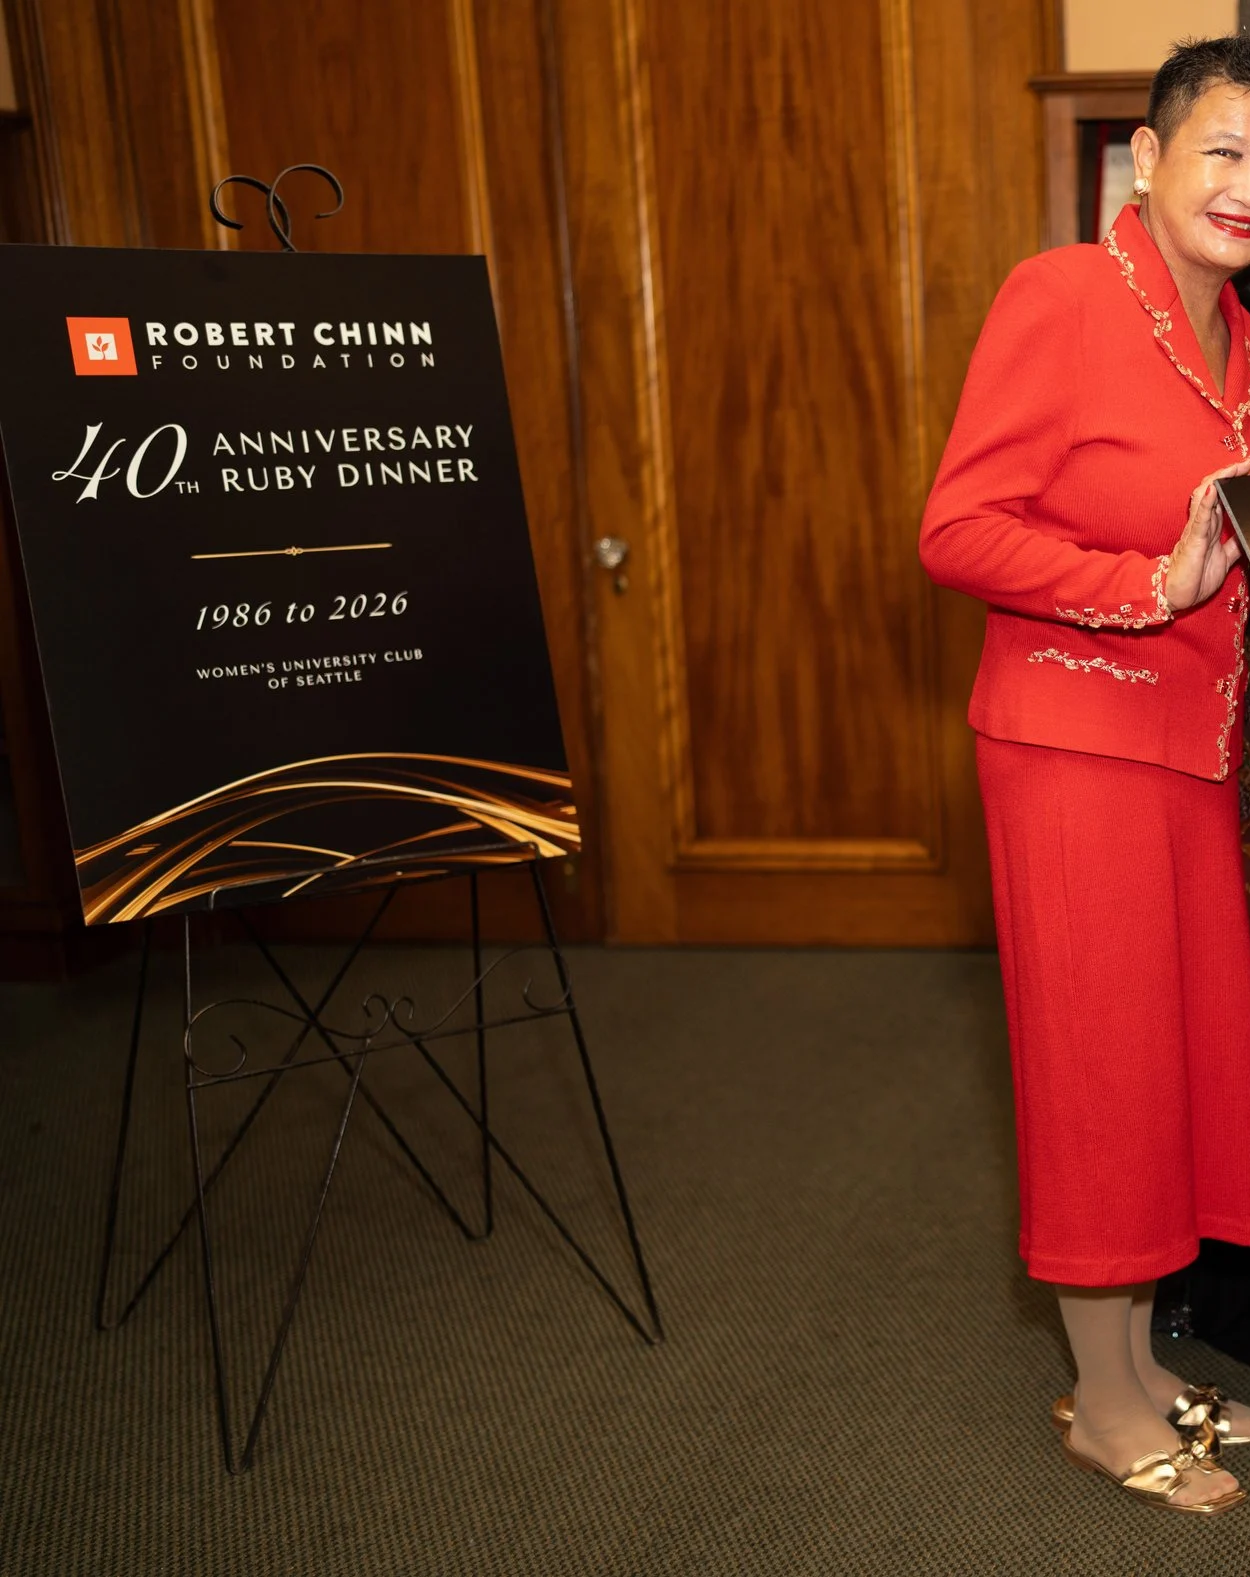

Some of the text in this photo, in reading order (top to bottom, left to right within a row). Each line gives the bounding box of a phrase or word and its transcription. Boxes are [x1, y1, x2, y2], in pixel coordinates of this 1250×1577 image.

[145, 321, 433, 347] ROBERT CHINN
[151, 352, 435, 370] FOUNDATION
[213, 424, 474, 456] ANNIVERSARY
[221, 458, 479, 492] RUBY DINNER
[196, 592, 408, 631] 1986 to 2026
[196, 648, 423, 680] WOMEN'S UNIVERSITY CLUB
[267, 669, 363, 690] OF SEATTLE
